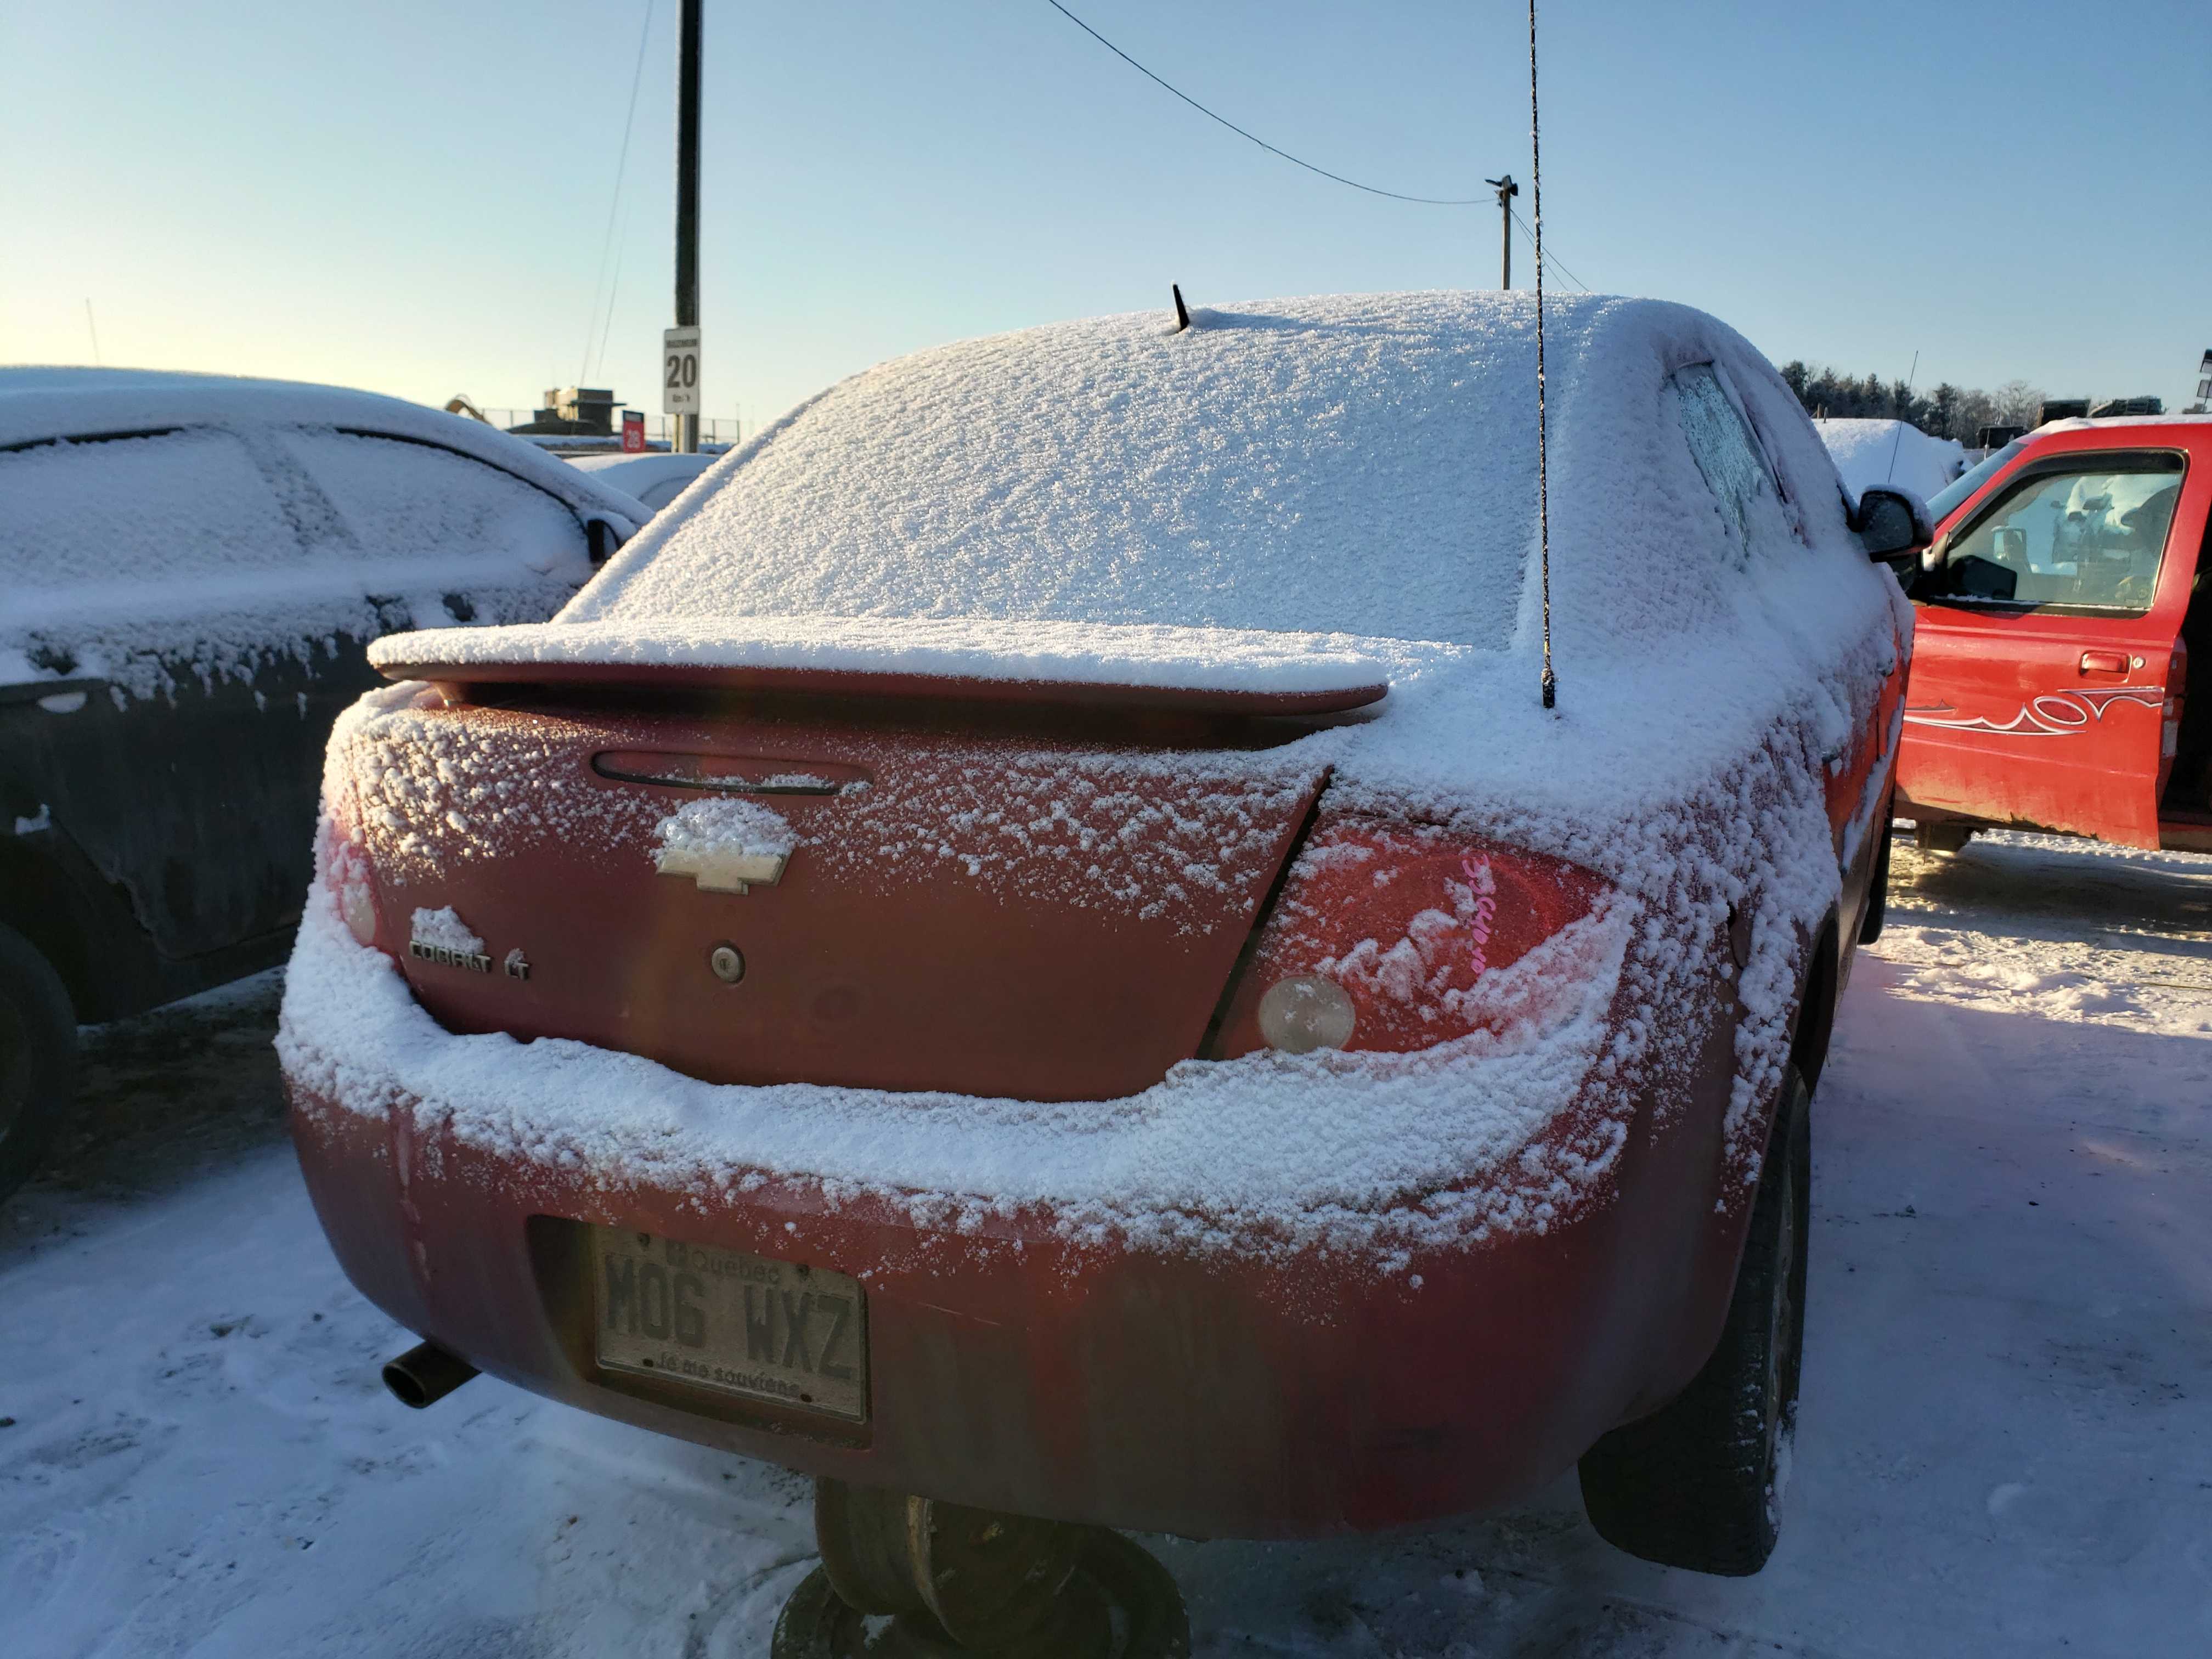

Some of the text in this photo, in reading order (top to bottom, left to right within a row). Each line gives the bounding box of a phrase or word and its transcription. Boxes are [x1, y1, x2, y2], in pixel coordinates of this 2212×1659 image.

[667, 354, 696, 388] 20
[409, 940, 492, 973] COBALT
[743, 1283, 853, 1379] WXZ
